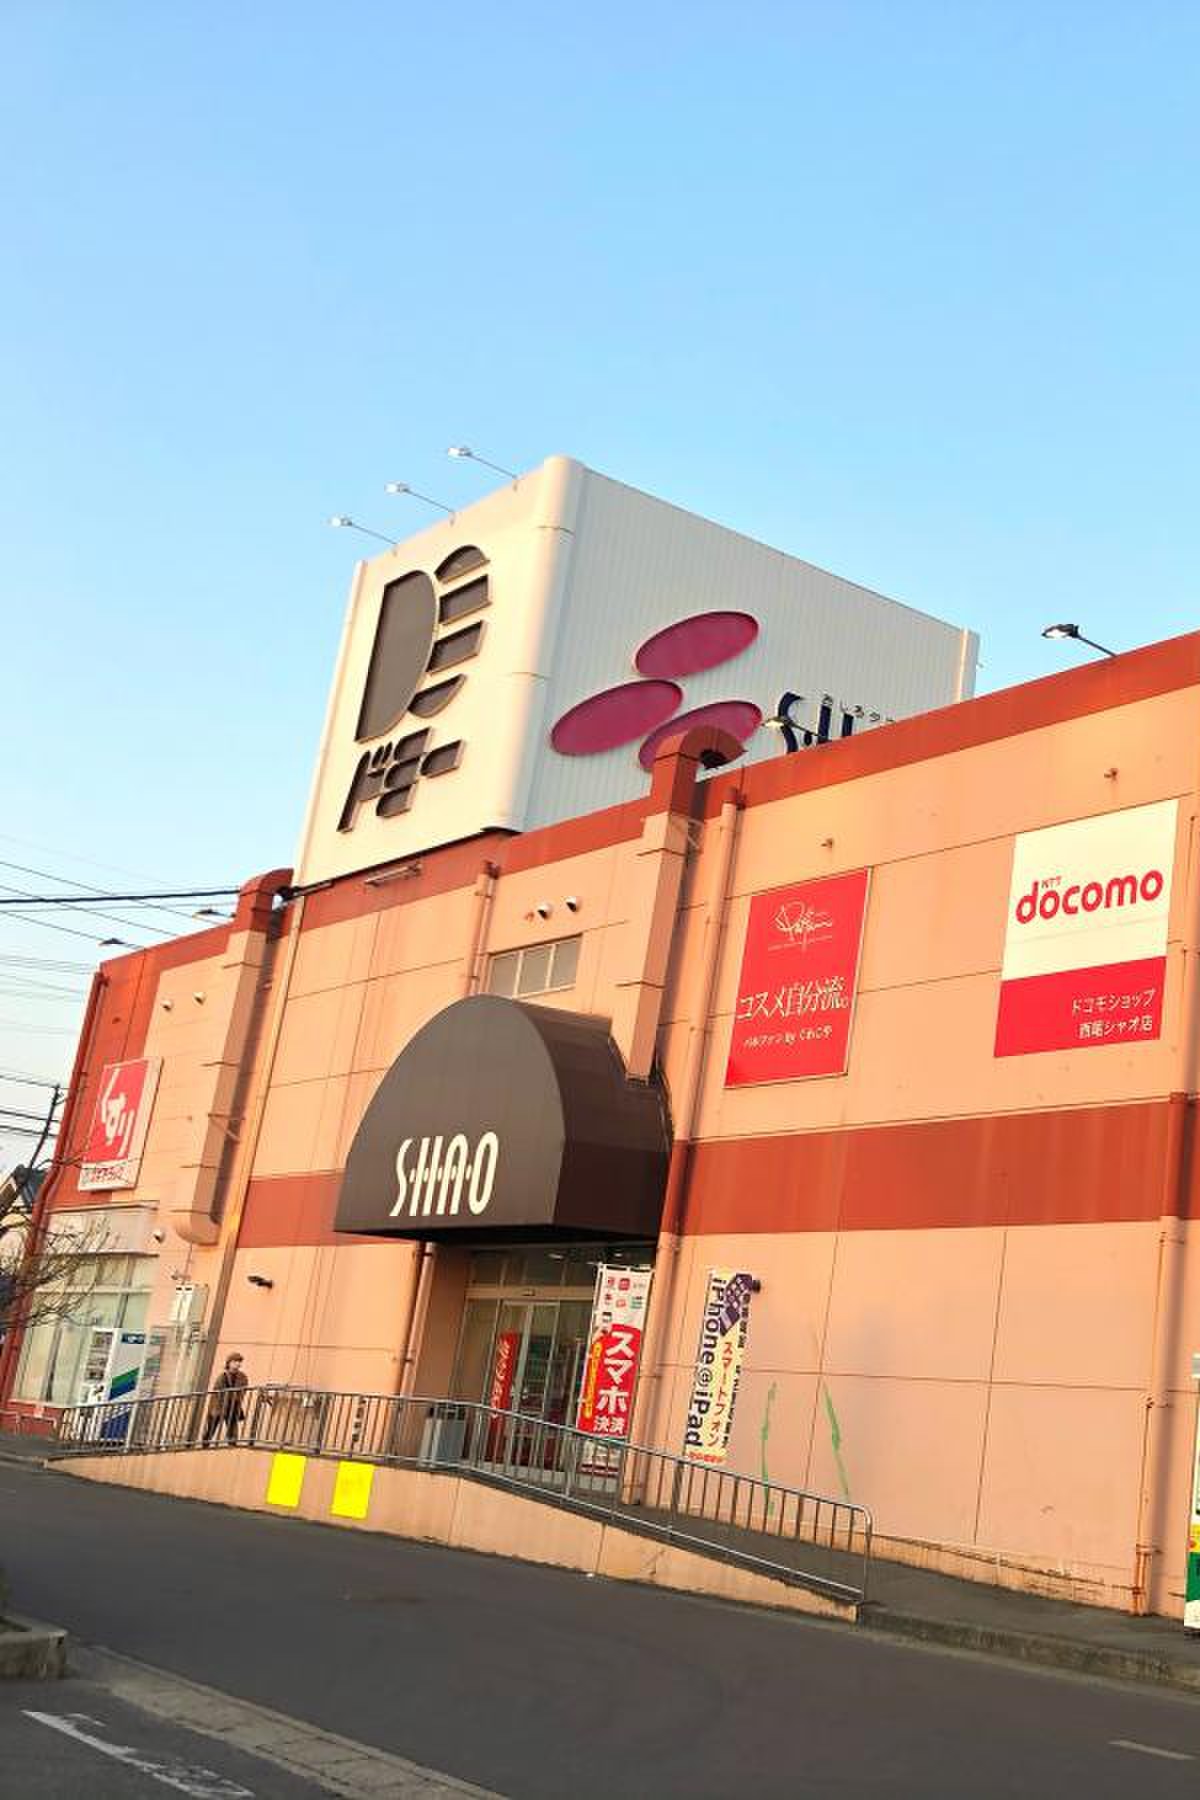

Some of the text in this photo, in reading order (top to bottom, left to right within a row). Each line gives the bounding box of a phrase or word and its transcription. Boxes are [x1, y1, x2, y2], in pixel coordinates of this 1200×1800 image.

[1015, 870, 1164, 925] docomo
[1073, 988, 1156, 1016] ドコモショップ
[595, 1331, 635, 1414] スマホ
